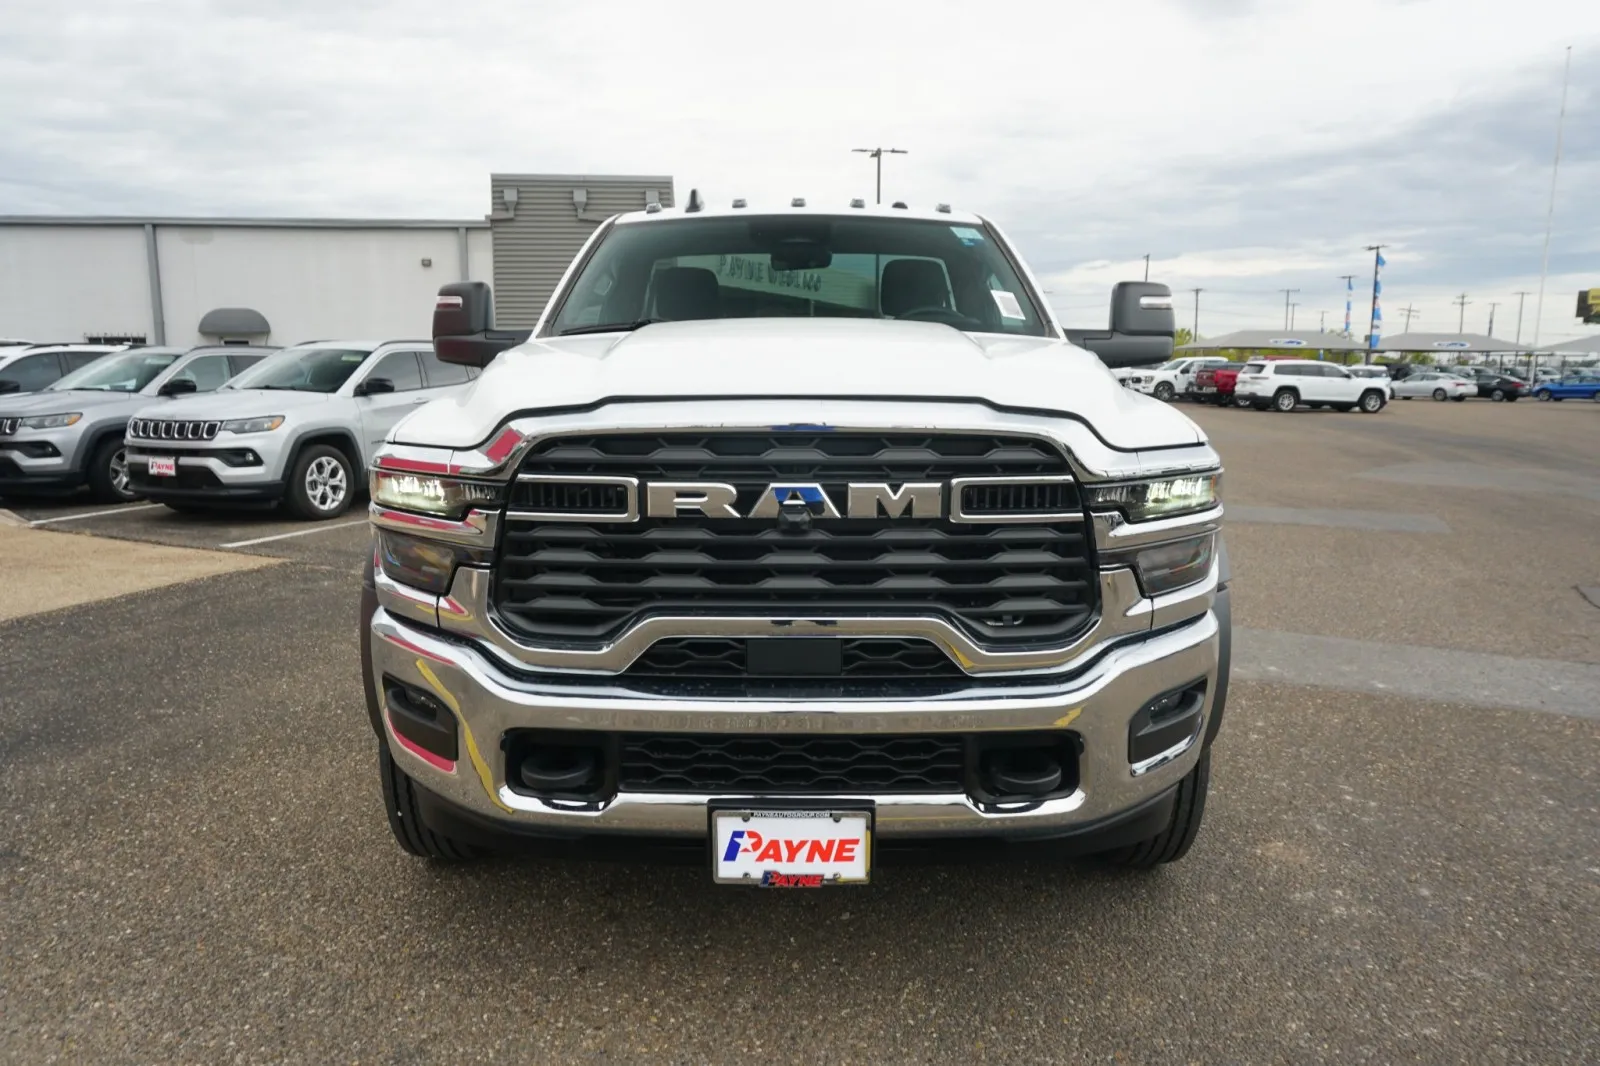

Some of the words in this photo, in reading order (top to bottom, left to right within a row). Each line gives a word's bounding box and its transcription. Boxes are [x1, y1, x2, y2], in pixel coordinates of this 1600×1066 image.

[151, 461, 174, 470] PAYNE
[647, 482, 942, 518] RAM
[723, 830, 860, 863] PAYNE
[760, 870, 824, 887] PAYNE
